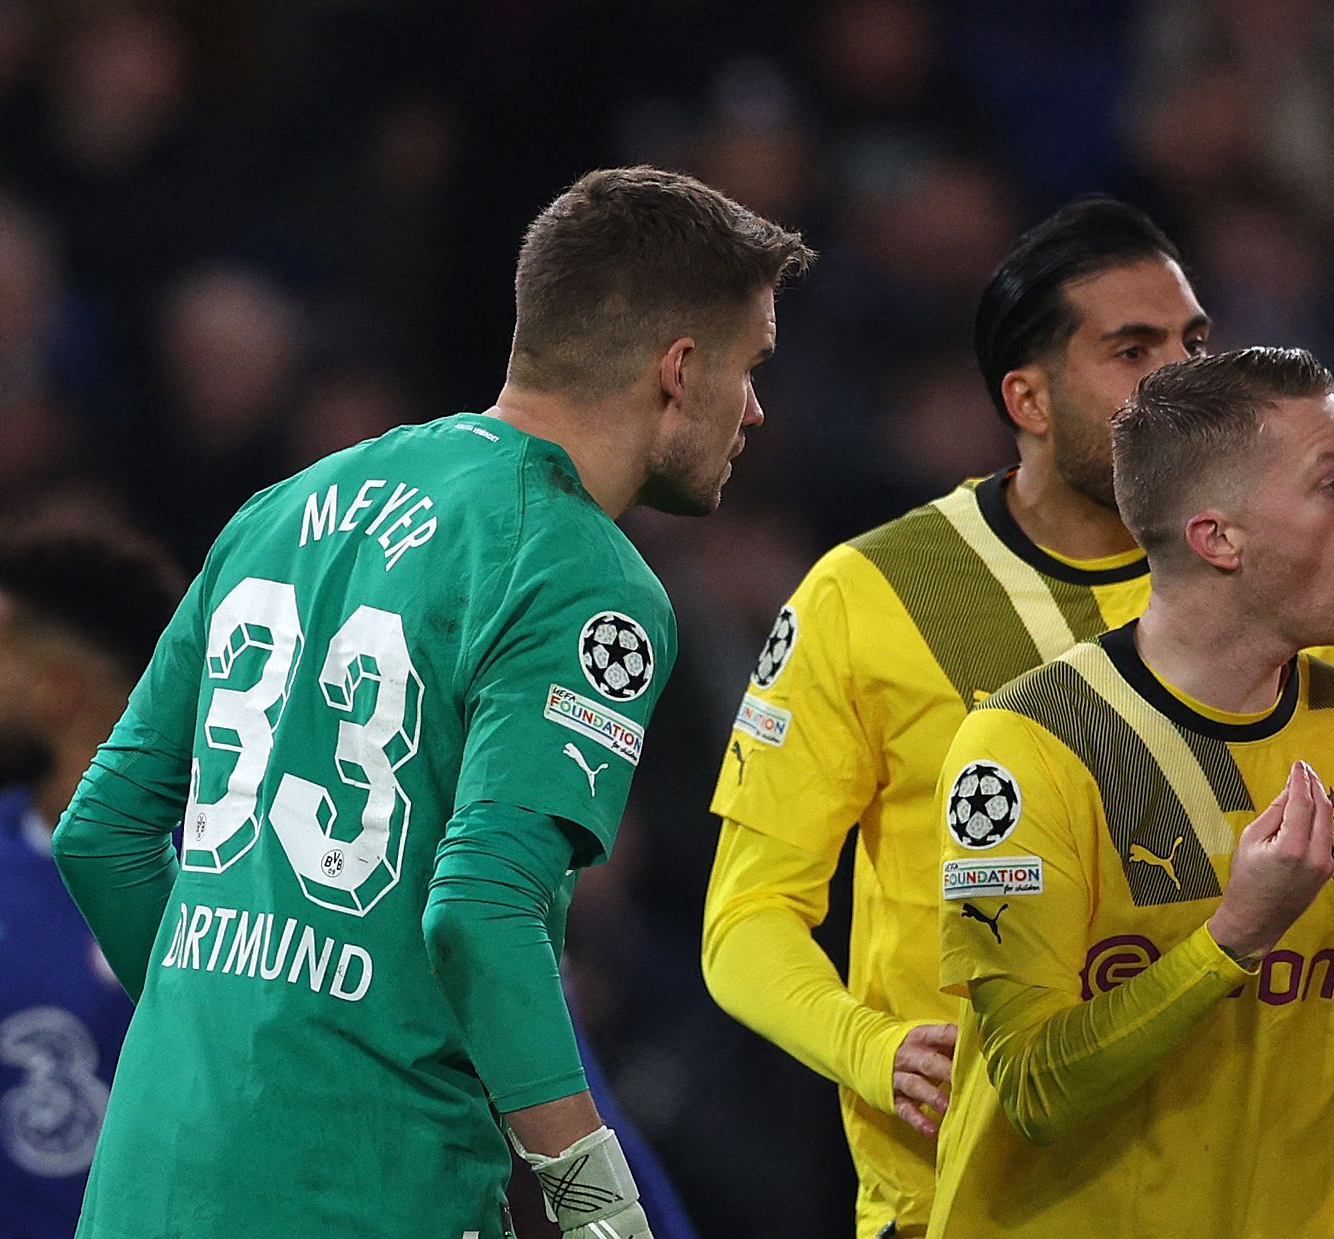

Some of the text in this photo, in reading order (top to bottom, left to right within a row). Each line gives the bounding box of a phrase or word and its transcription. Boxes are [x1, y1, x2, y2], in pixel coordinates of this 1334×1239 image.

[299, 480, 437, 572] MEYER
[553, 687, 575, 702] UEFA
[182, 577, 425, 917] 33
[324, 851, 343, 870] BVB
